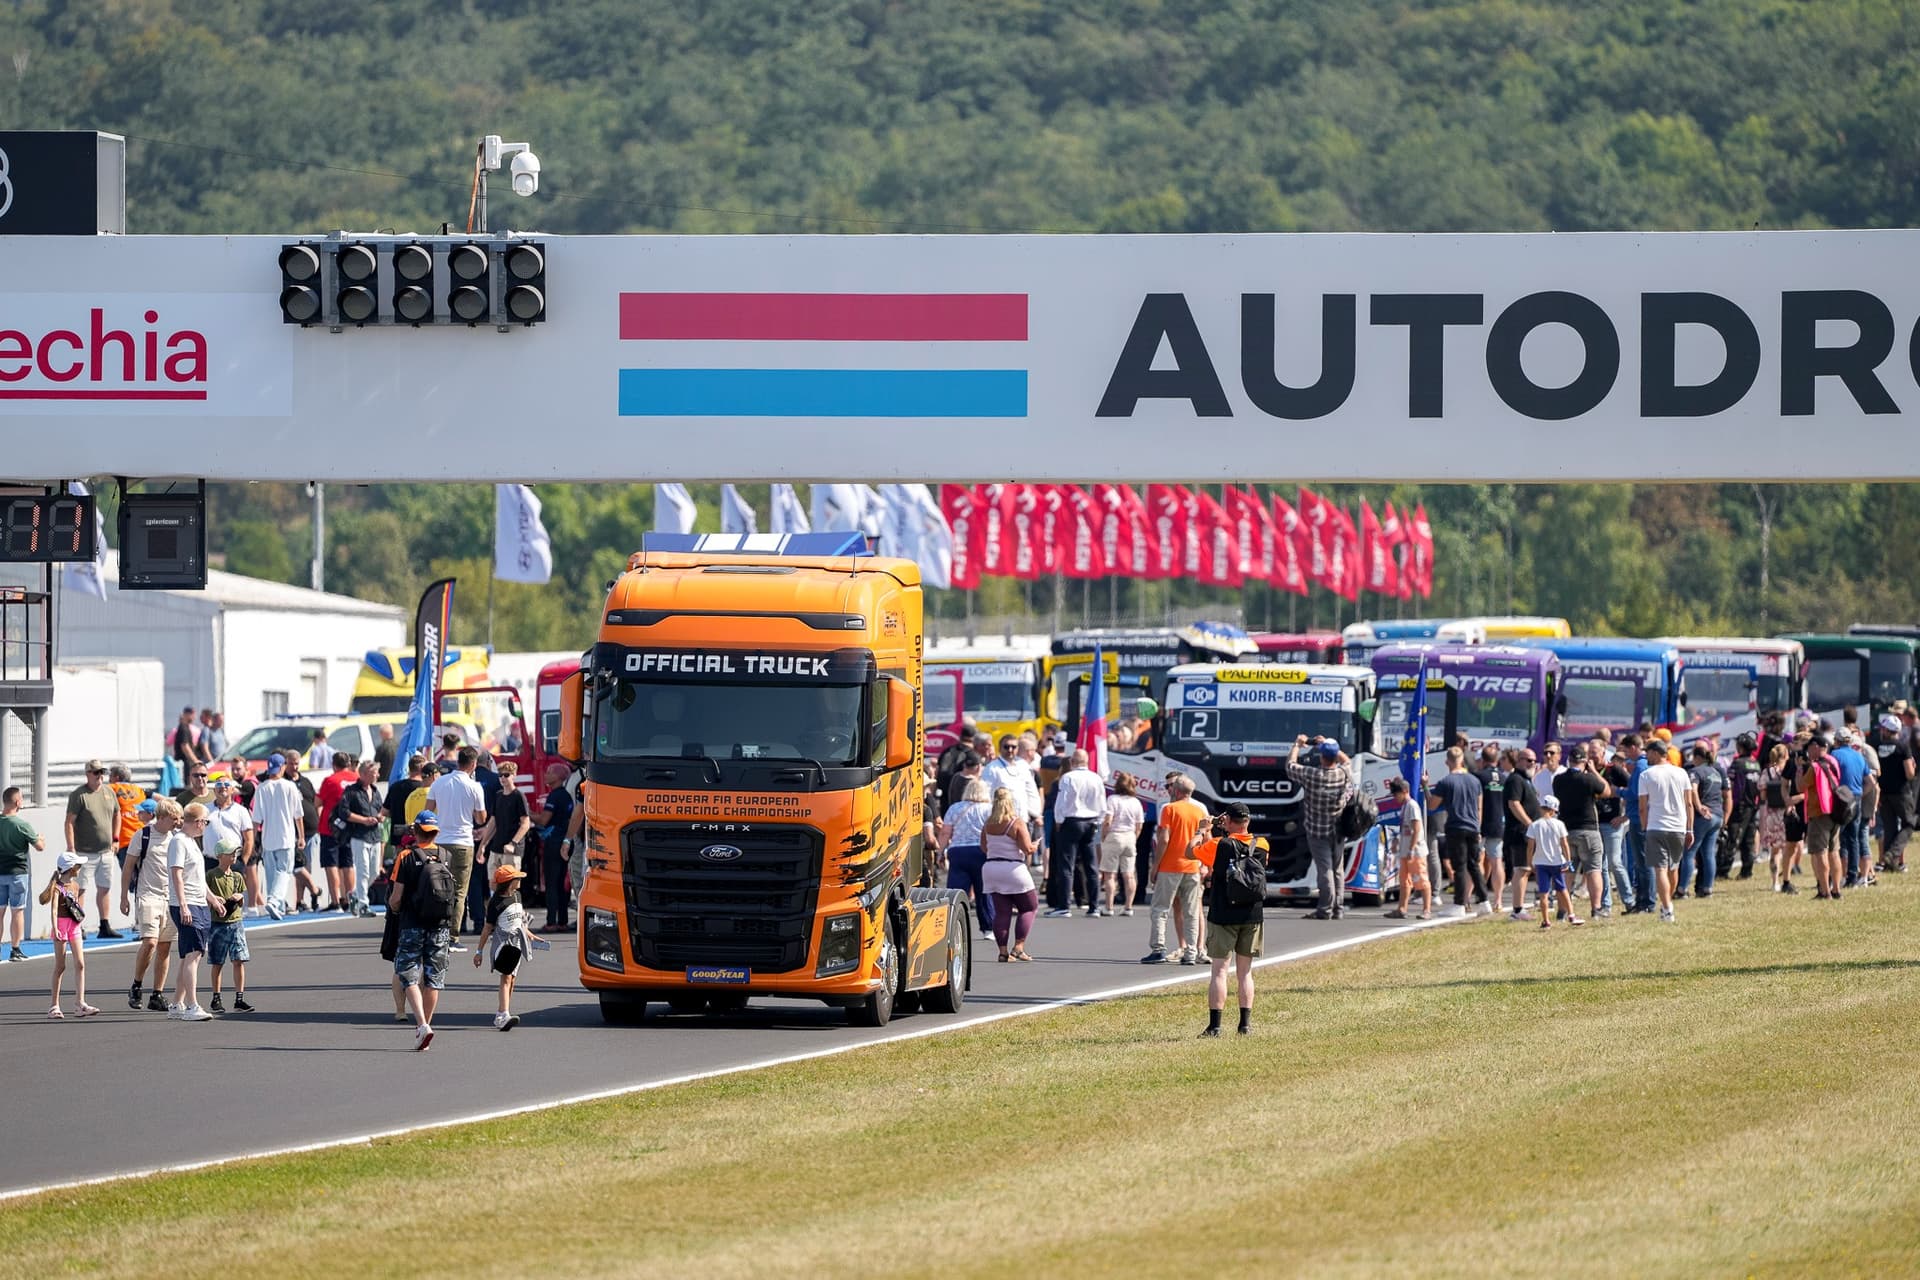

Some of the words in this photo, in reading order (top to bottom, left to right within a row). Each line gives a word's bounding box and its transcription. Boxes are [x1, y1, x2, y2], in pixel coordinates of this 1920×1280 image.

[1095, 290, 1920, 420] AUTODR
[625, 653, 735, 673] OFFICIAL
[744, 655, 830, 677] TRUCK
[1459, 675, 1532, 693] TYRES
[1229, 689, 1341, 704] KNORR-BREMSE
[1389, 701, 1406, 721] 3
[1190, 712, 1208, 737] 2
[1223, 780, 1292, 793] IVECO
[646, 794, 709, 804] GOODYEAR
[713, 795, 731, 804] FIA
[736, 796, 799, 806] EUROPEAN
[634, 805, 671, 815] TRUCK
[676, 806, 719, 816] RACING
[724, 807, 812, 818] CHAMPIONSHIP
[709, 847, 733, 858] Ford
[691, 969, 745, 979] GOODYEAR
